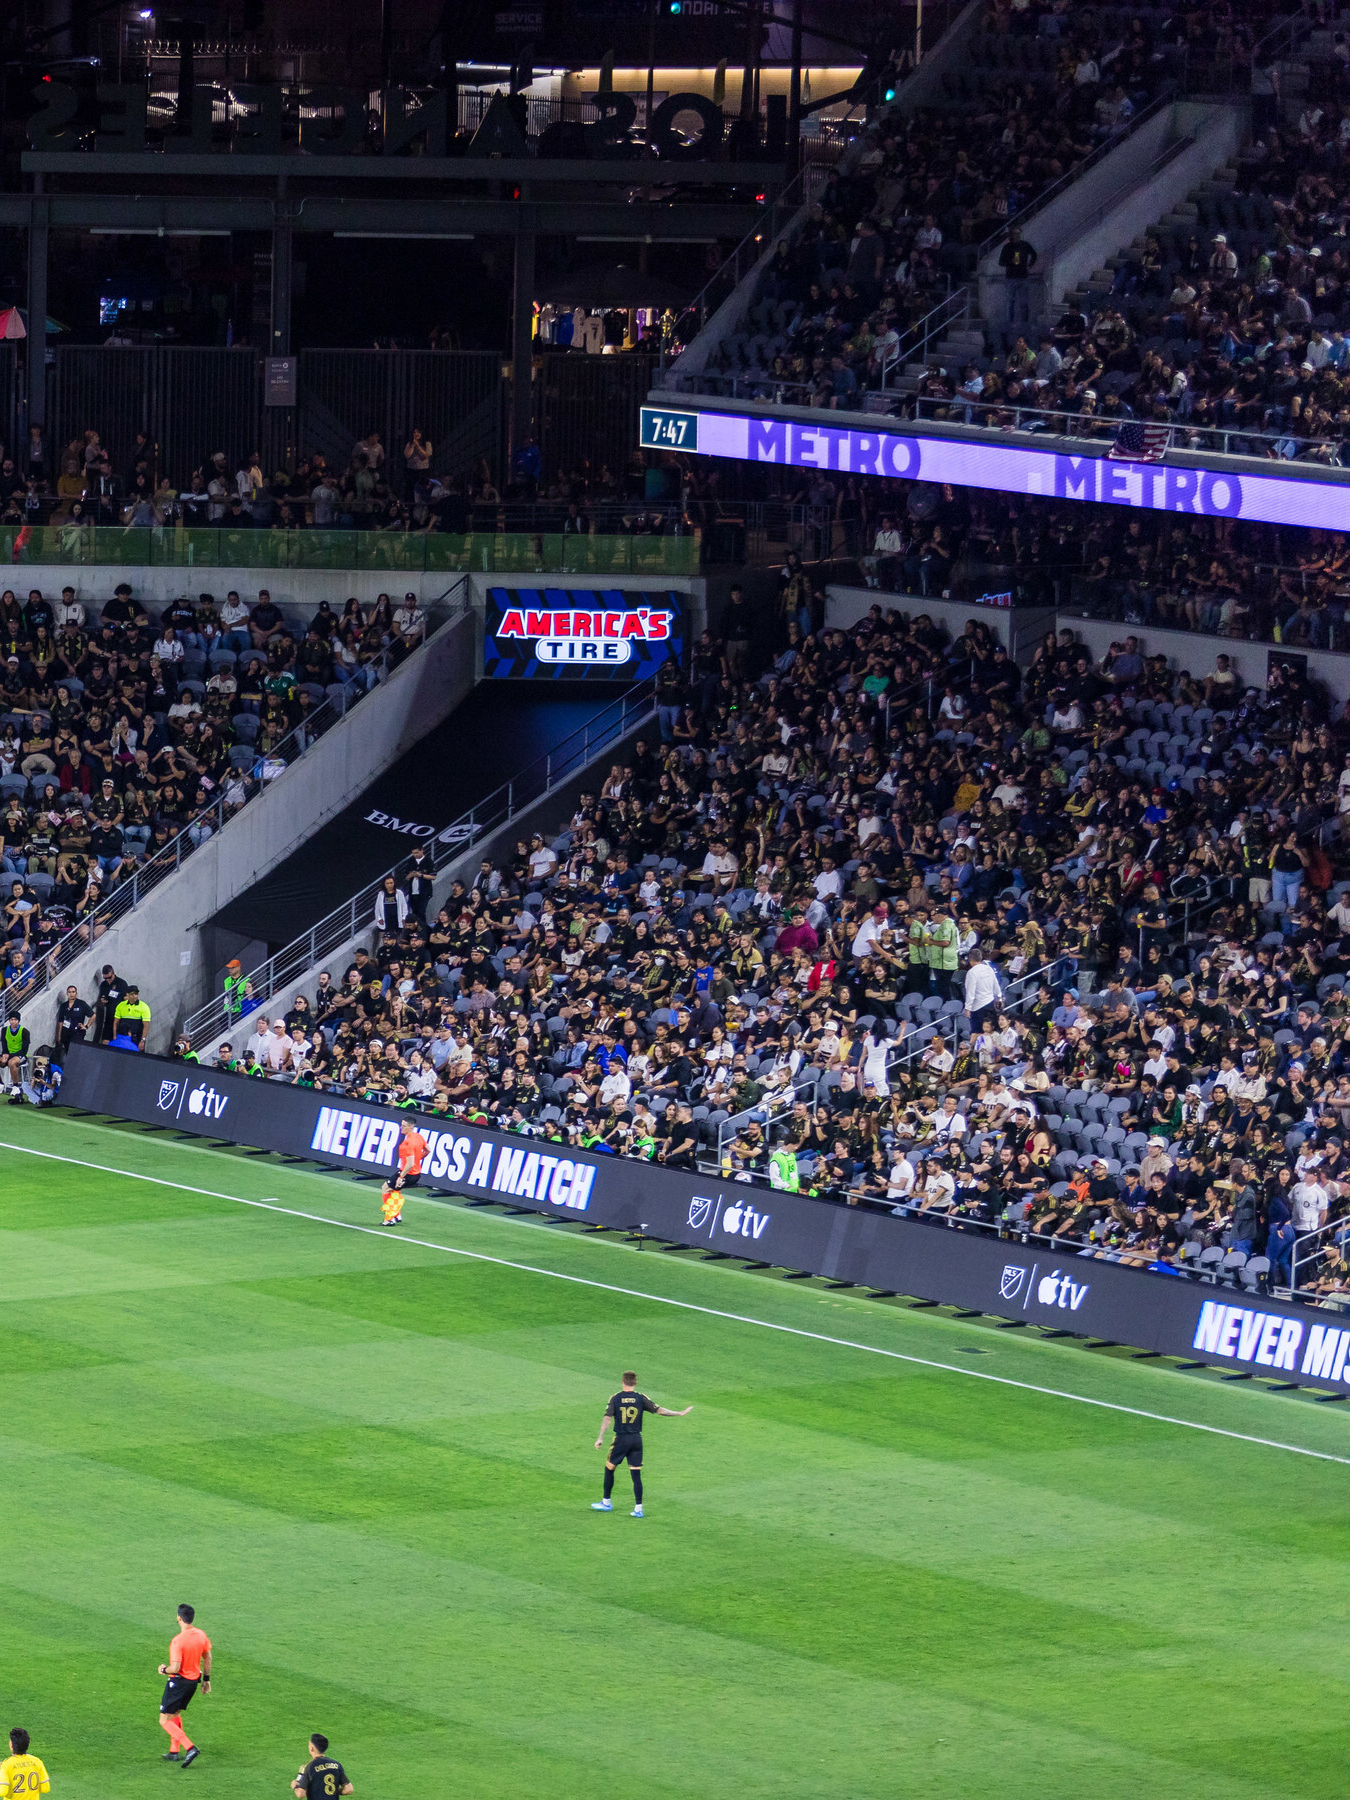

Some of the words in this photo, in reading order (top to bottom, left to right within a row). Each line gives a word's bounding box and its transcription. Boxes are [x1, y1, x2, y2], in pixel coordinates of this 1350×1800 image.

[494, 13, 543, 24] SERVICE
[591, 327, 598, 340] 7
[652, 417, 688, 444] 7:47
[748, 420, 921, 480] METRO
[1054, 454, 1243, 518] METRO
[497, 608, 671, 640] AMERICA'S
[546, 642, 618, 659] TIRE
[363, 808, 435, 837] BMO
[203, 1087, 228, 1119] tv
[311, 1106, 401, 1166] NEVER
[412, 1127, 471, 1182] ISS
[467, 1141, 495, 1188] A
[491, 1146, 597, 1211] MATCH
[741, 1206, 769, 1239] tv
[1058, 1275, 1089, 1310] tv
[1192, 1300, 1306, 1371] NEVER
[1300, 1323, 1350, 1385] MI
[620, 1406, 638, 1424] 19
[13, 1771, 40, 1794] 20
[323, 1773, 336, 1796] 8
